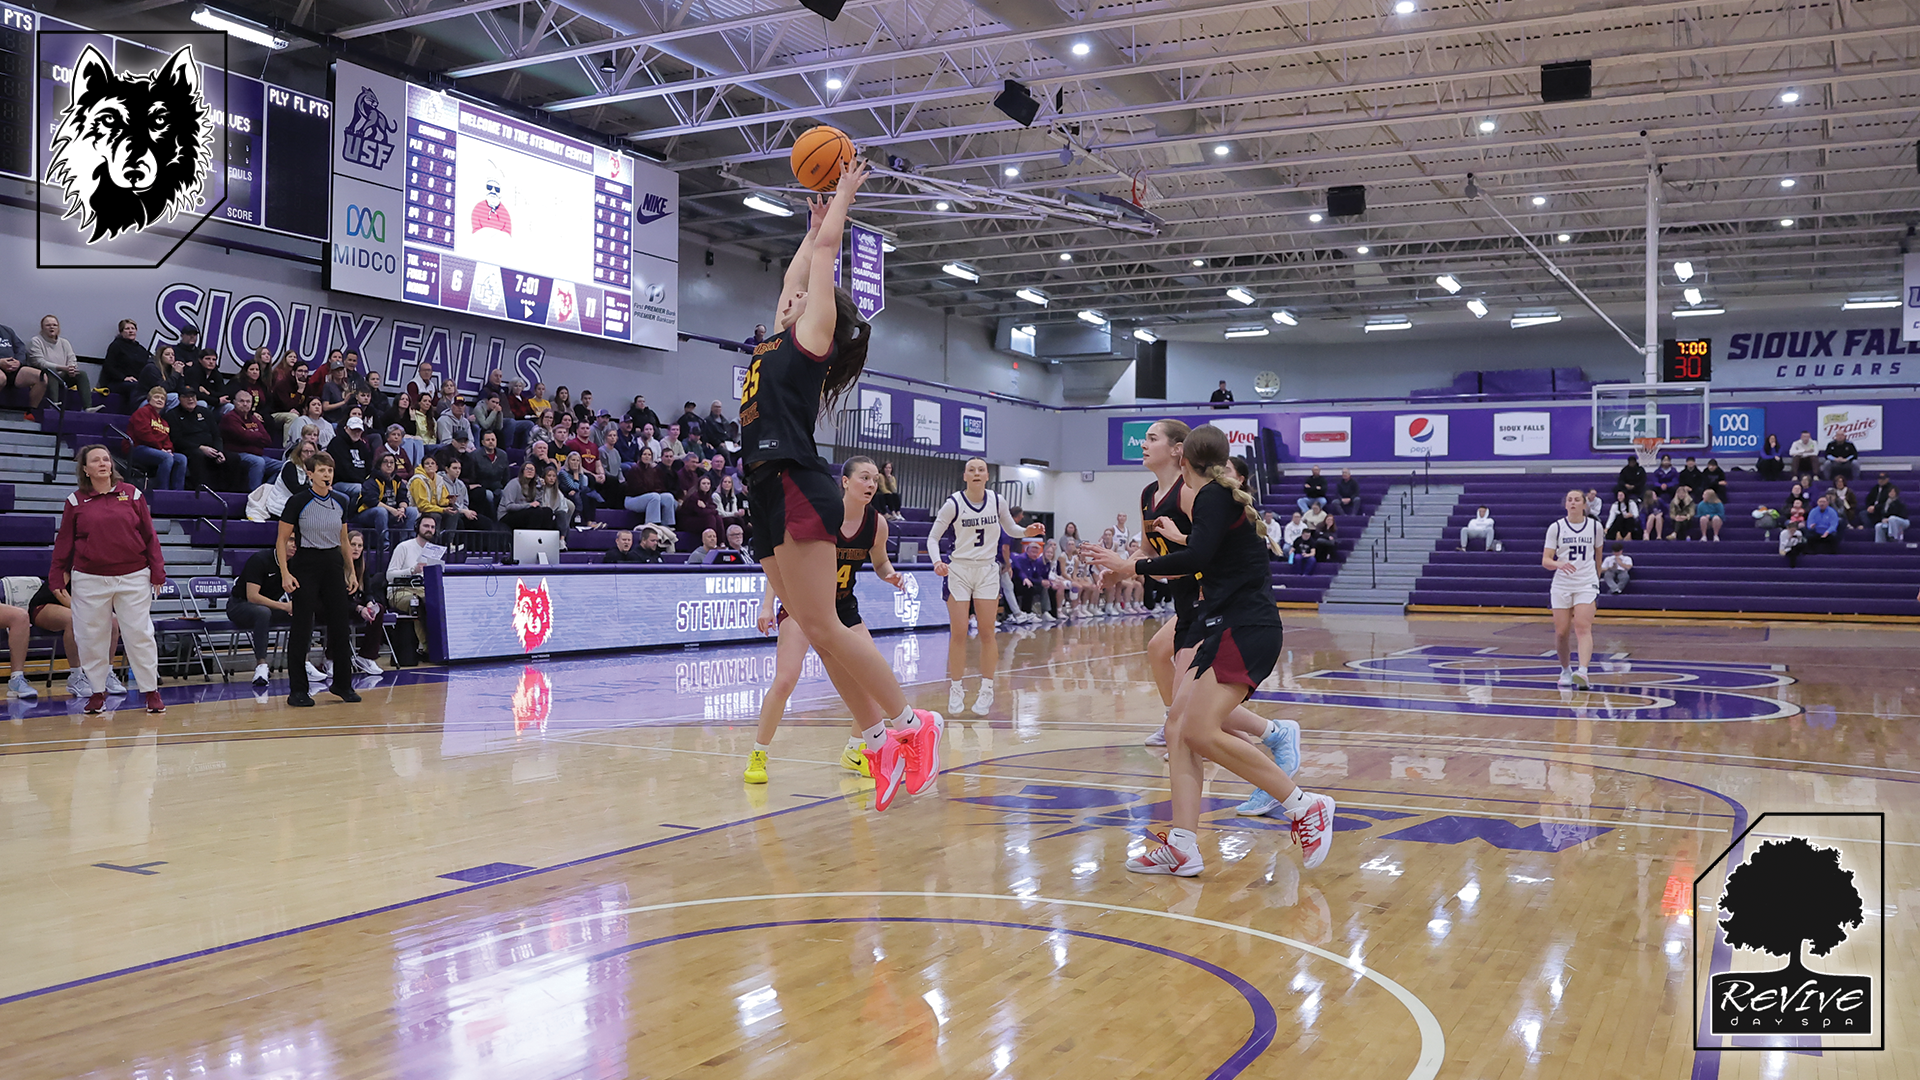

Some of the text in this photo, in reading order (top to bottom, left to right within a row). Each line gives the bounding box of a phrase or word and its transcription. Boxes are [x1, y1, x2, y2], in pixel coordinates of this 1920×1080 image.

[4, 8, 33, 31] PTS
[269, 88, 330, 119] PLY FL PTS
[459, 110, 501, 136] WELCOME
[501, 125, 513, 140] TO
[514, 128, 530, 145] THE
[564, 145, 593, 166] CENTER
[343, 129, 396, 171] USF
[642, 193, 669, 214] NIKE
[227, 207, 253, 221] SCORE
[333, 243, 396, 274] MIDCO
[431, 271, 437, 284] 1
[450, 269, 464, 292] 6
[853, 266, 880, 280] CHAMPIONS
[515, 274, 540, 296] 7:01
[852, 277, 880, 297] FOOTBALL
[585, 297, 597, 318] 11
[644, 304, 666, 314] PREMIER
[665, 309, 676, 317] Bank
[858, 296, 874, 312] 2016
[634, 310, 656, 321] PREMIER
[150, 282, 546, 400] SIOUX FALLS
[1677, 341, 1708, 356] 7:00
[1727, 329, 1838, 360] SIOUX
[1674, 355, 1702, 378] 30
[1776, 362, 1902, 378] COUGARS
[968, 418, 982, 428] FIRST
[1823, 417, 1877, 437] Prairie
[1711, 434, 1757, 447] MIDCO
[962, 515, 997, 527] SIOUX FALLS
[974, 528, 985, 547] 3
[1568, 545, 1587, 561] 24
[195, 584, 227, 593] COUGARS
[706, 576, 767, 594] WELCOME T
[676, 598, 760, 632] STEWART
[894, 591, 921, 627] USF
